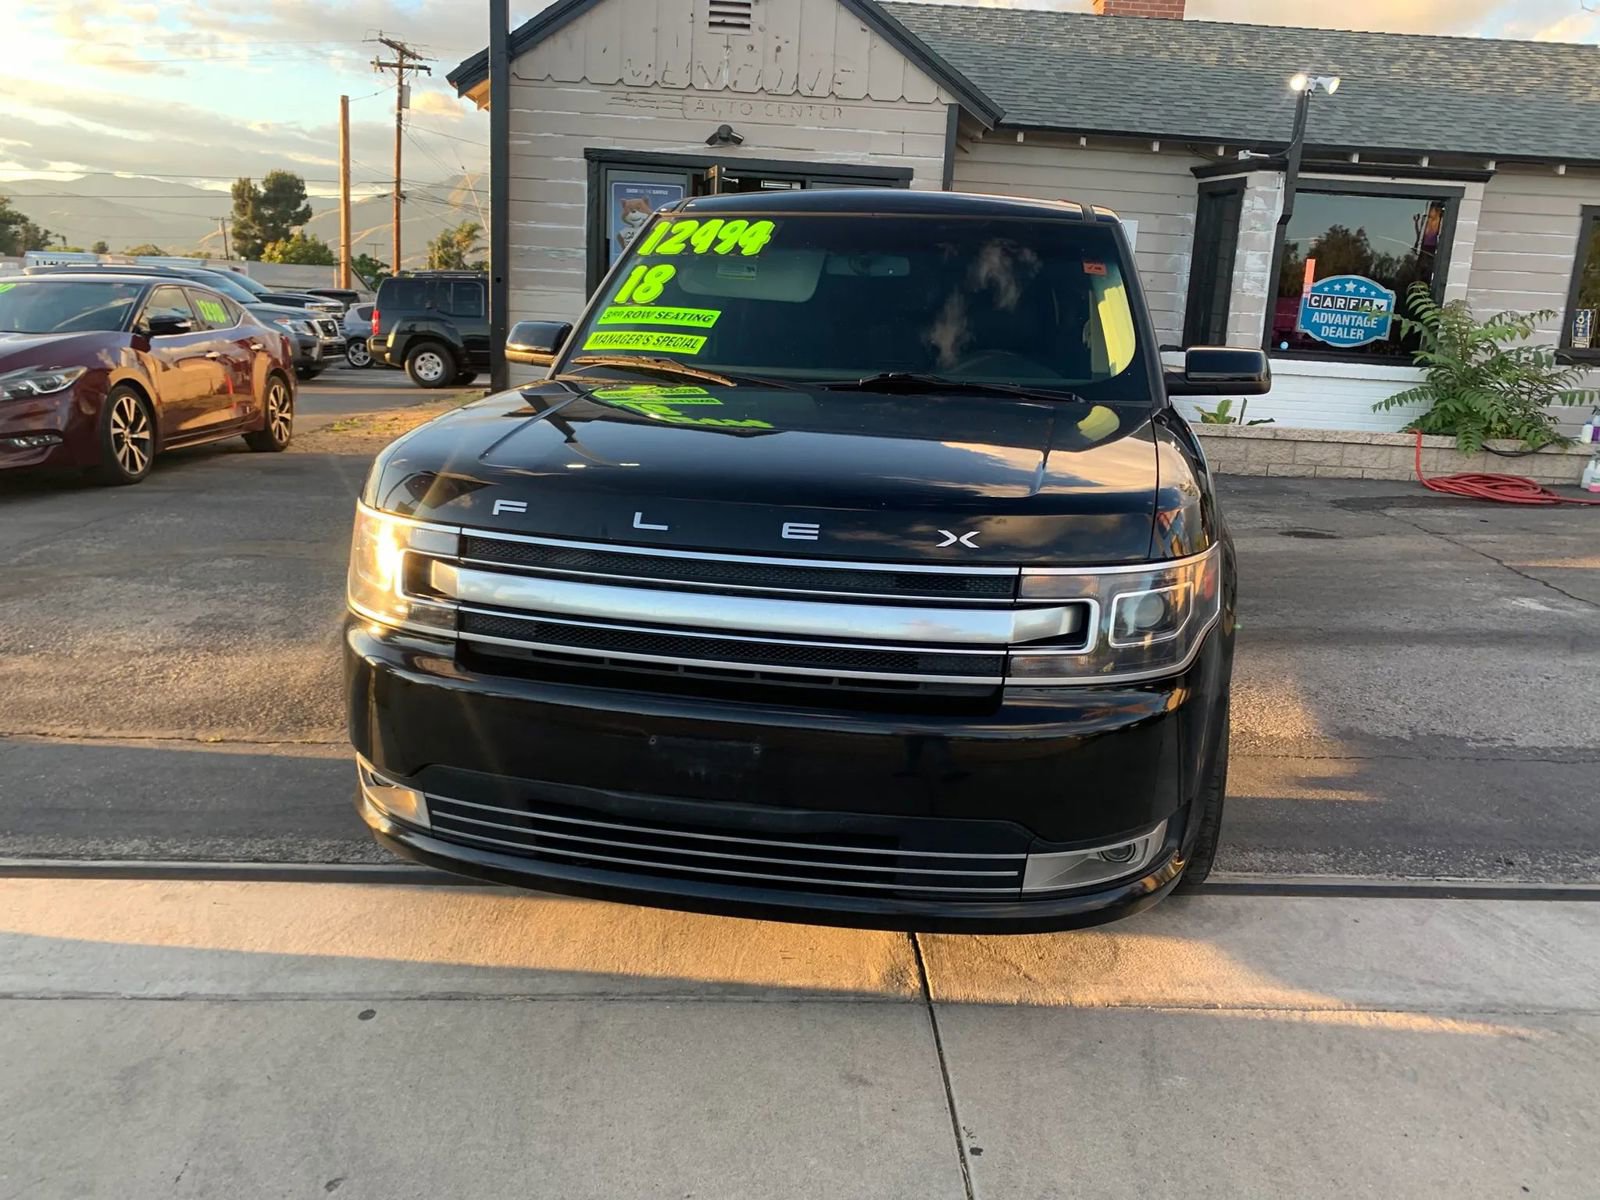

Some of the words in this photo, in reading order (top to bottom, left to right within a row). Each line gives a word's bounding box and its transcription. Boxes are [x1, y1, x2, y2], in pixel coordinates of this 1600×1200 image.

[637, 218, 775, 256] 12494
[614, 264, 677, 304] 18
[624, 310, 656, 320] ROW
[655, 311, 714, 323] SEATING
[1311, 311, 1378, 328] ADVANTAGE
[594, 333, 652, 346] MANAGER'S
[653, 335, 701, 349] SPECIAL
[1321, 326, 1364, 340] DEALER
